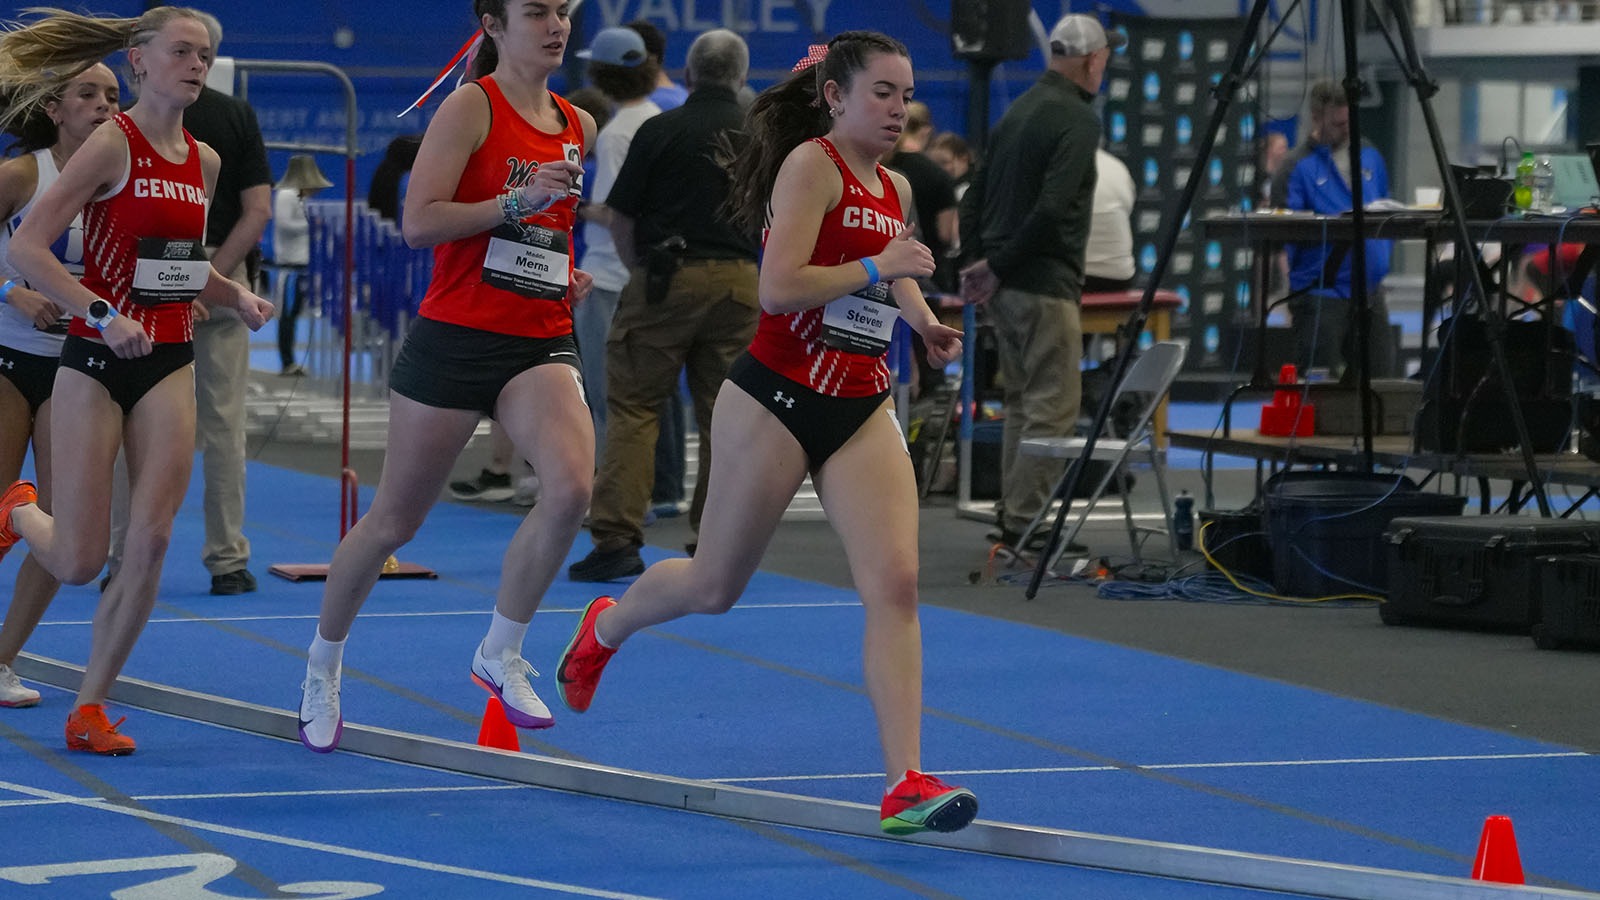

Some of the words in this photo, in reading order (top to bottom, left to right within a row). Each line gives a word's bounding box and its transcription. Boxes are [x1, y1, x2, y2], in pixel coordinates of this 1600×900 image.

[599, 0, 829, 32] VALLEY
[134, 178, 206, 205] CENTRA
[843, 206, 906, 237] CENTR
[515, 255, 549, 272] Merna
[157, 271, 190, 281] Cordes
[846, 309, 883, 329] Stevens
